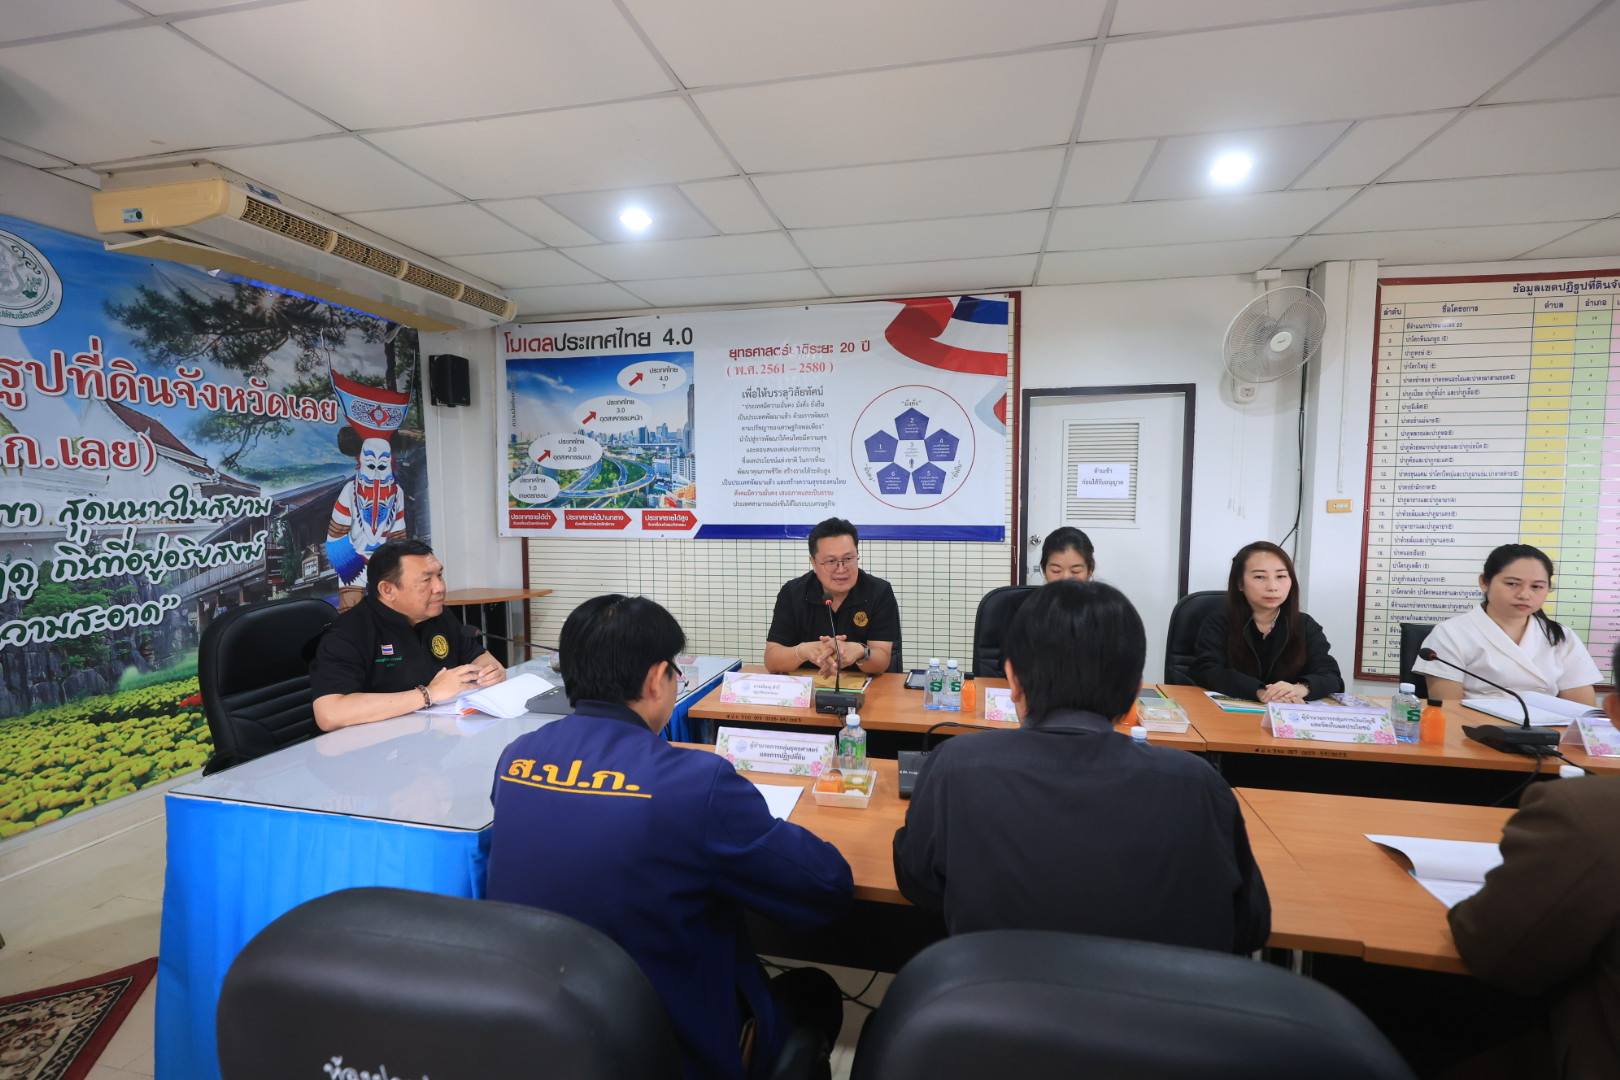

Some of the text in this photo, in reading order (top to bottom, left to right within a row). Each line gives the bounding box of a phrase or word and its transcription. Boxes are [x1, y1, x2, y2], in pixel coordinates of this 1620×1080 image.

[1512, 277, 1620, 295] ข้อมูลเขตปฏิรูปที่ดินจั
[1545, 300, 1564, 309] ตำบล
[1585, 298, 1607, 307] อำเภอ
[504, 327, 693, 353] โมเดลประเทศไทย 4.0
[840, 342, 855, 353] 20
[861, 340, 870, 352] ปี
[799, 362, 825, 374] 2580
[0, 337, 337, 422] รูปที่ดินจังหวัดเลย
[59, 485, 271, 538] สุดหนาวในสยาม
[56, 527, 267, 581] ถิ่นที่อยู่อริยสงฆ์
[508, 758, 640, 791] ส.ป.ก.
